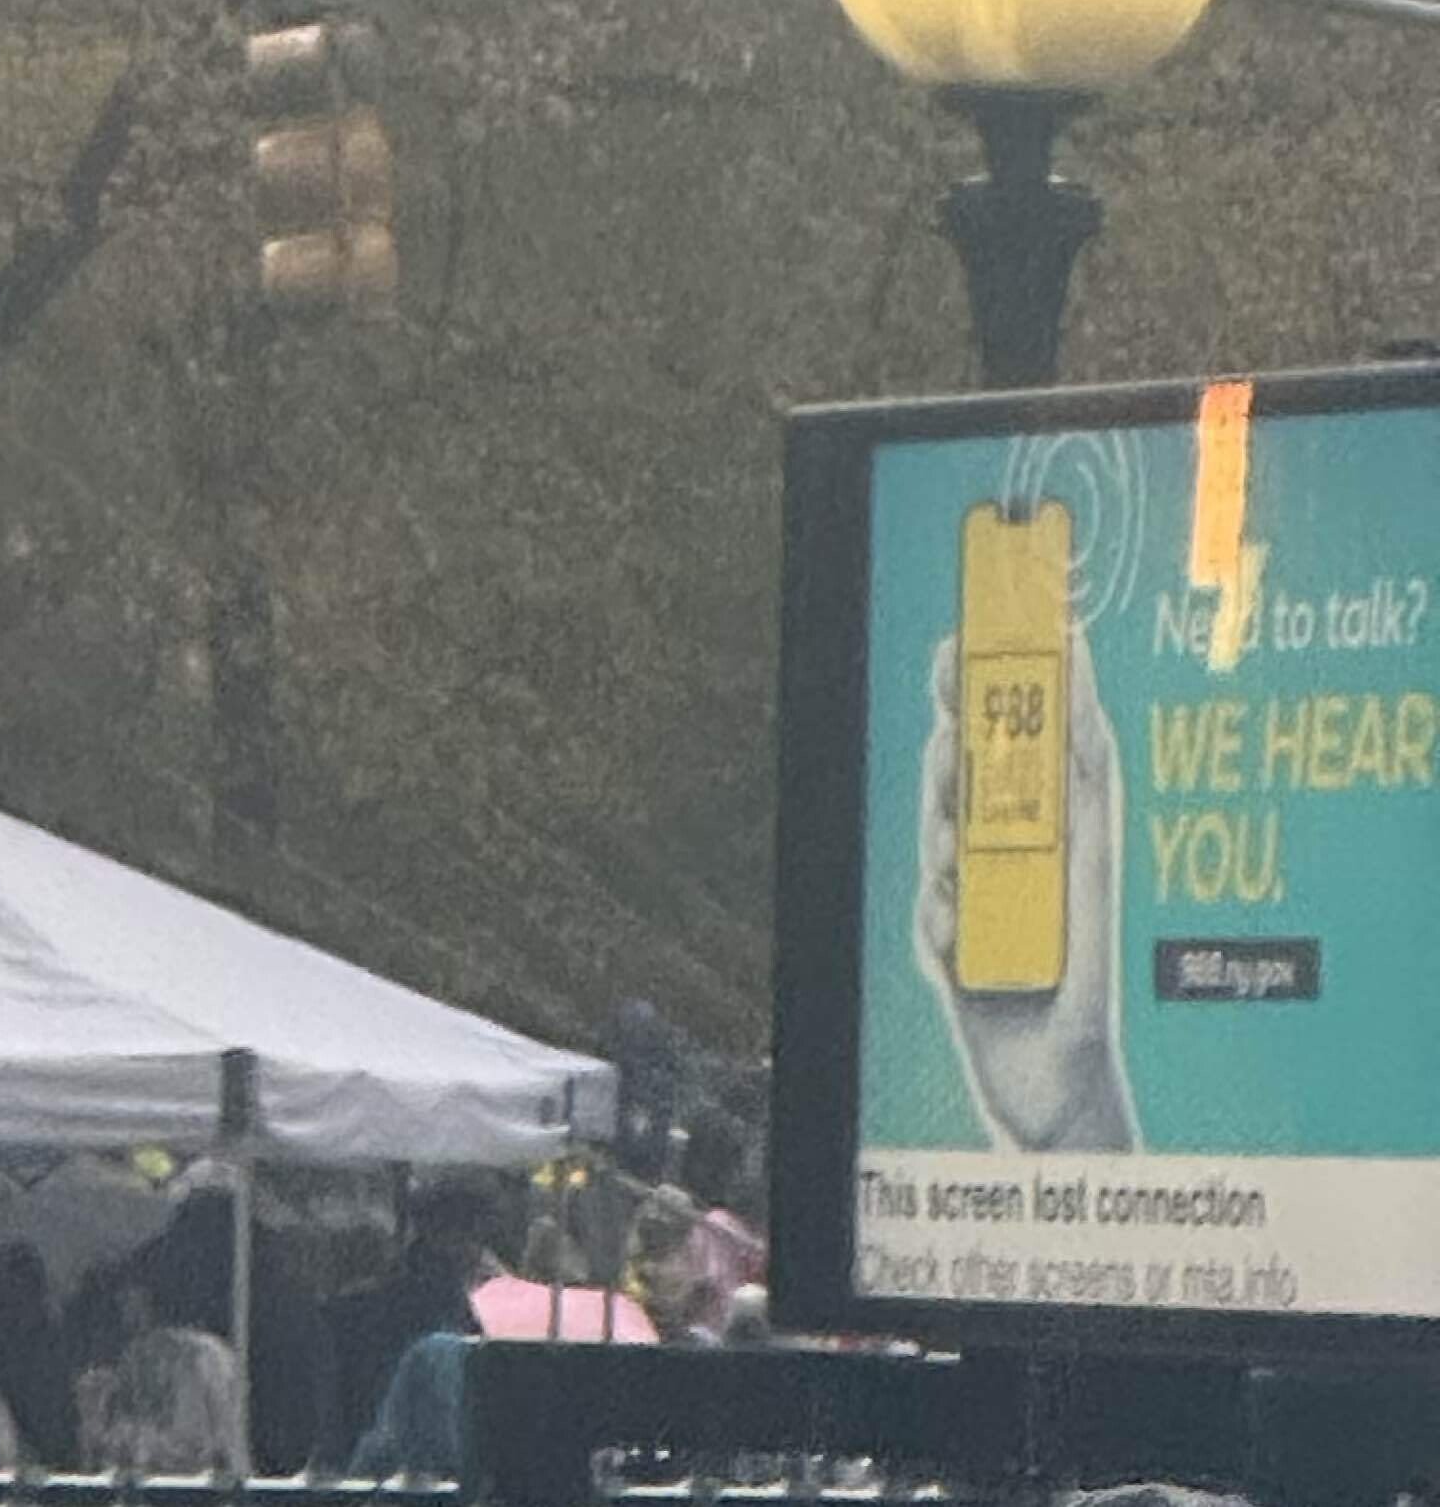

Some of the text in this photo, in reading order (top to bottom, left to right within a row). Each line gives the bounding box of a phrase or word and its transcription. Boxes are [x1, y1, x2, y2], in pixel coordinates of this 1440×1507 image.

[1274, 591, 1314, 651] to
[1328, 575, 1428, 650] talk?
[1149, 697, 1247, 793] WE
[1261, 690, 1437, 791] HEAR
[1149, 809, 1285, 905] YOU.
[862, 1169, 1268, 1228] This screen lost connection
